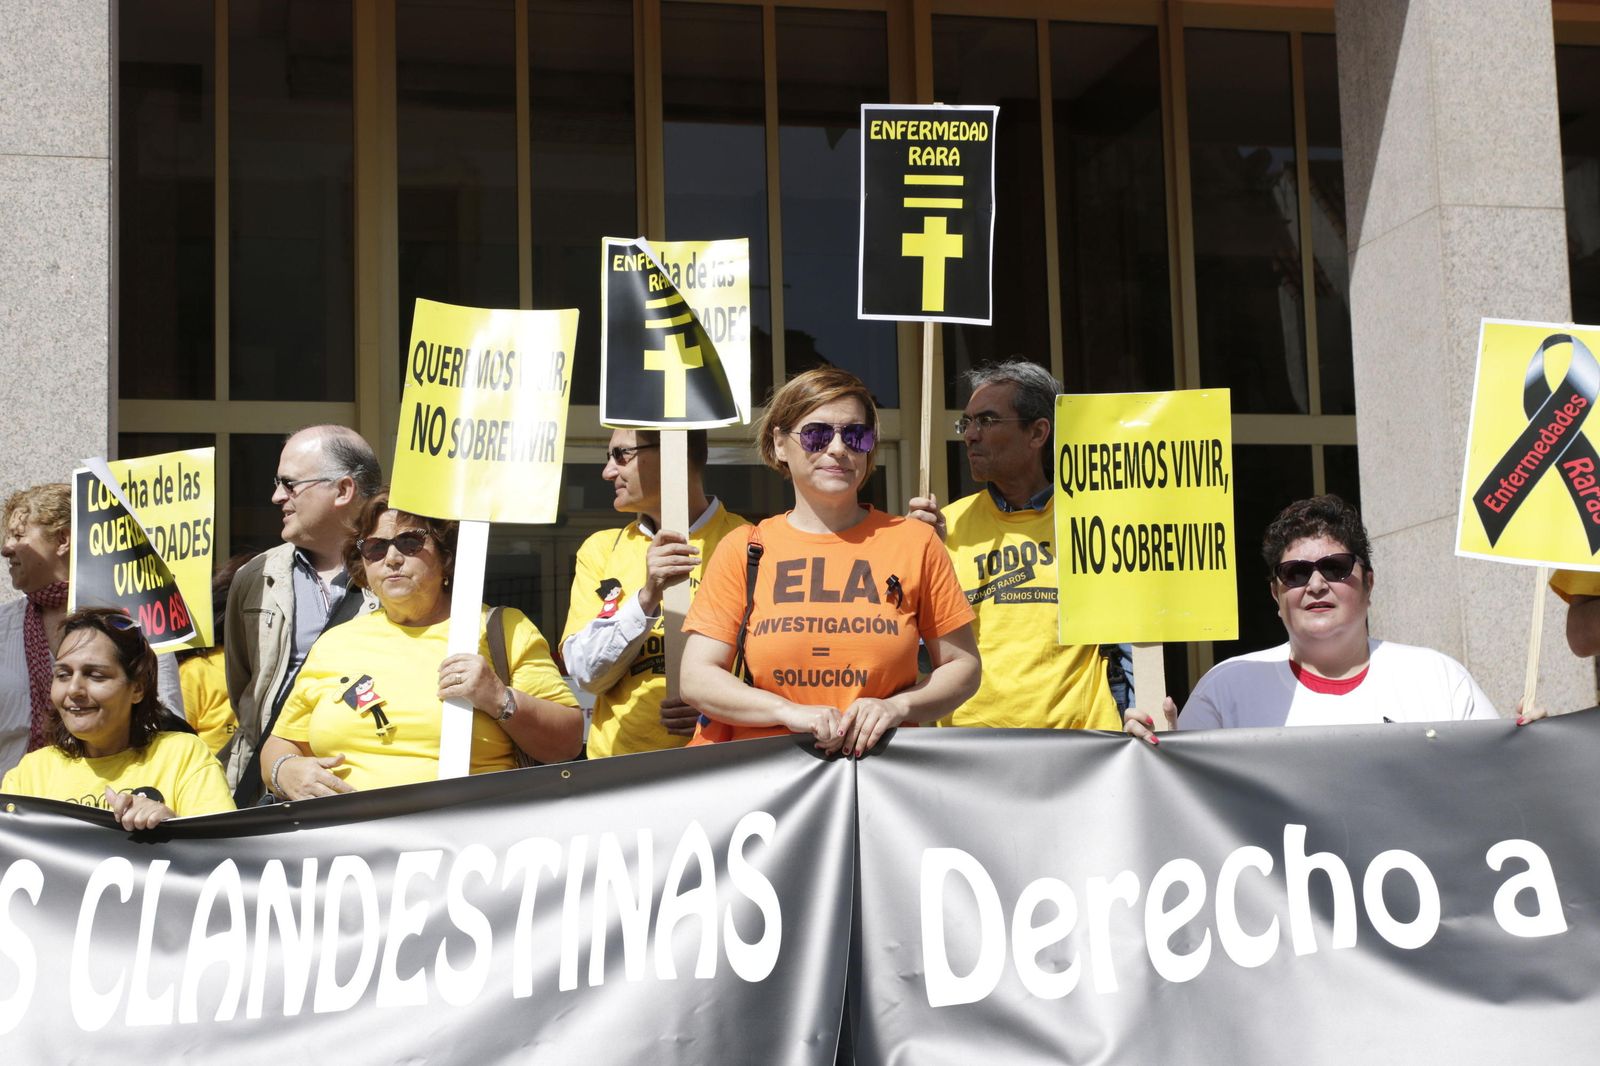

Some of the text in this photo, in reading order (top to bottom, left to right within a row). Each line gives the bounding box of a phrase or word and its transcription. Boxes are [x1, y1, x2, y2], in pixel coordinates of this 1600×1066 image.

[870, 120, 988, 141] ENFERMEDAD
[908, 146, 960, 166] RARA
[613, 252, 656, 271] ENFE
[686, 251, 707, 289] de
[410, 402, 446, 456] NO
[1059, 438, 1229, 498] QUEREMOS VIVIR,
[1483, 393, 1588, 513] Enfermedades
[153, 465, 173, 507] de
[178, 462, 201, 502] las
[974, 541, 1054, 580] TODOS
[1070, 515, 1227, 574] NO SOBREVIVIR
[113, 554, 164, 597] VIVIR,
[773, 557, 881, 605] ELA
[967, 572, 1026, 603] SOMOS RAROS
[1001, 591, 1032, 600] SOMOS
[138, 600, 166, 637] NO
[753, 614, 898, 636] INVESTIGACIÓN
[773, 664, 868, 687] SOLUCIÓN
[70, 810, 782, 1032] CLANDESTINAS
[920, 823, 1568, 1008] Derecho a
